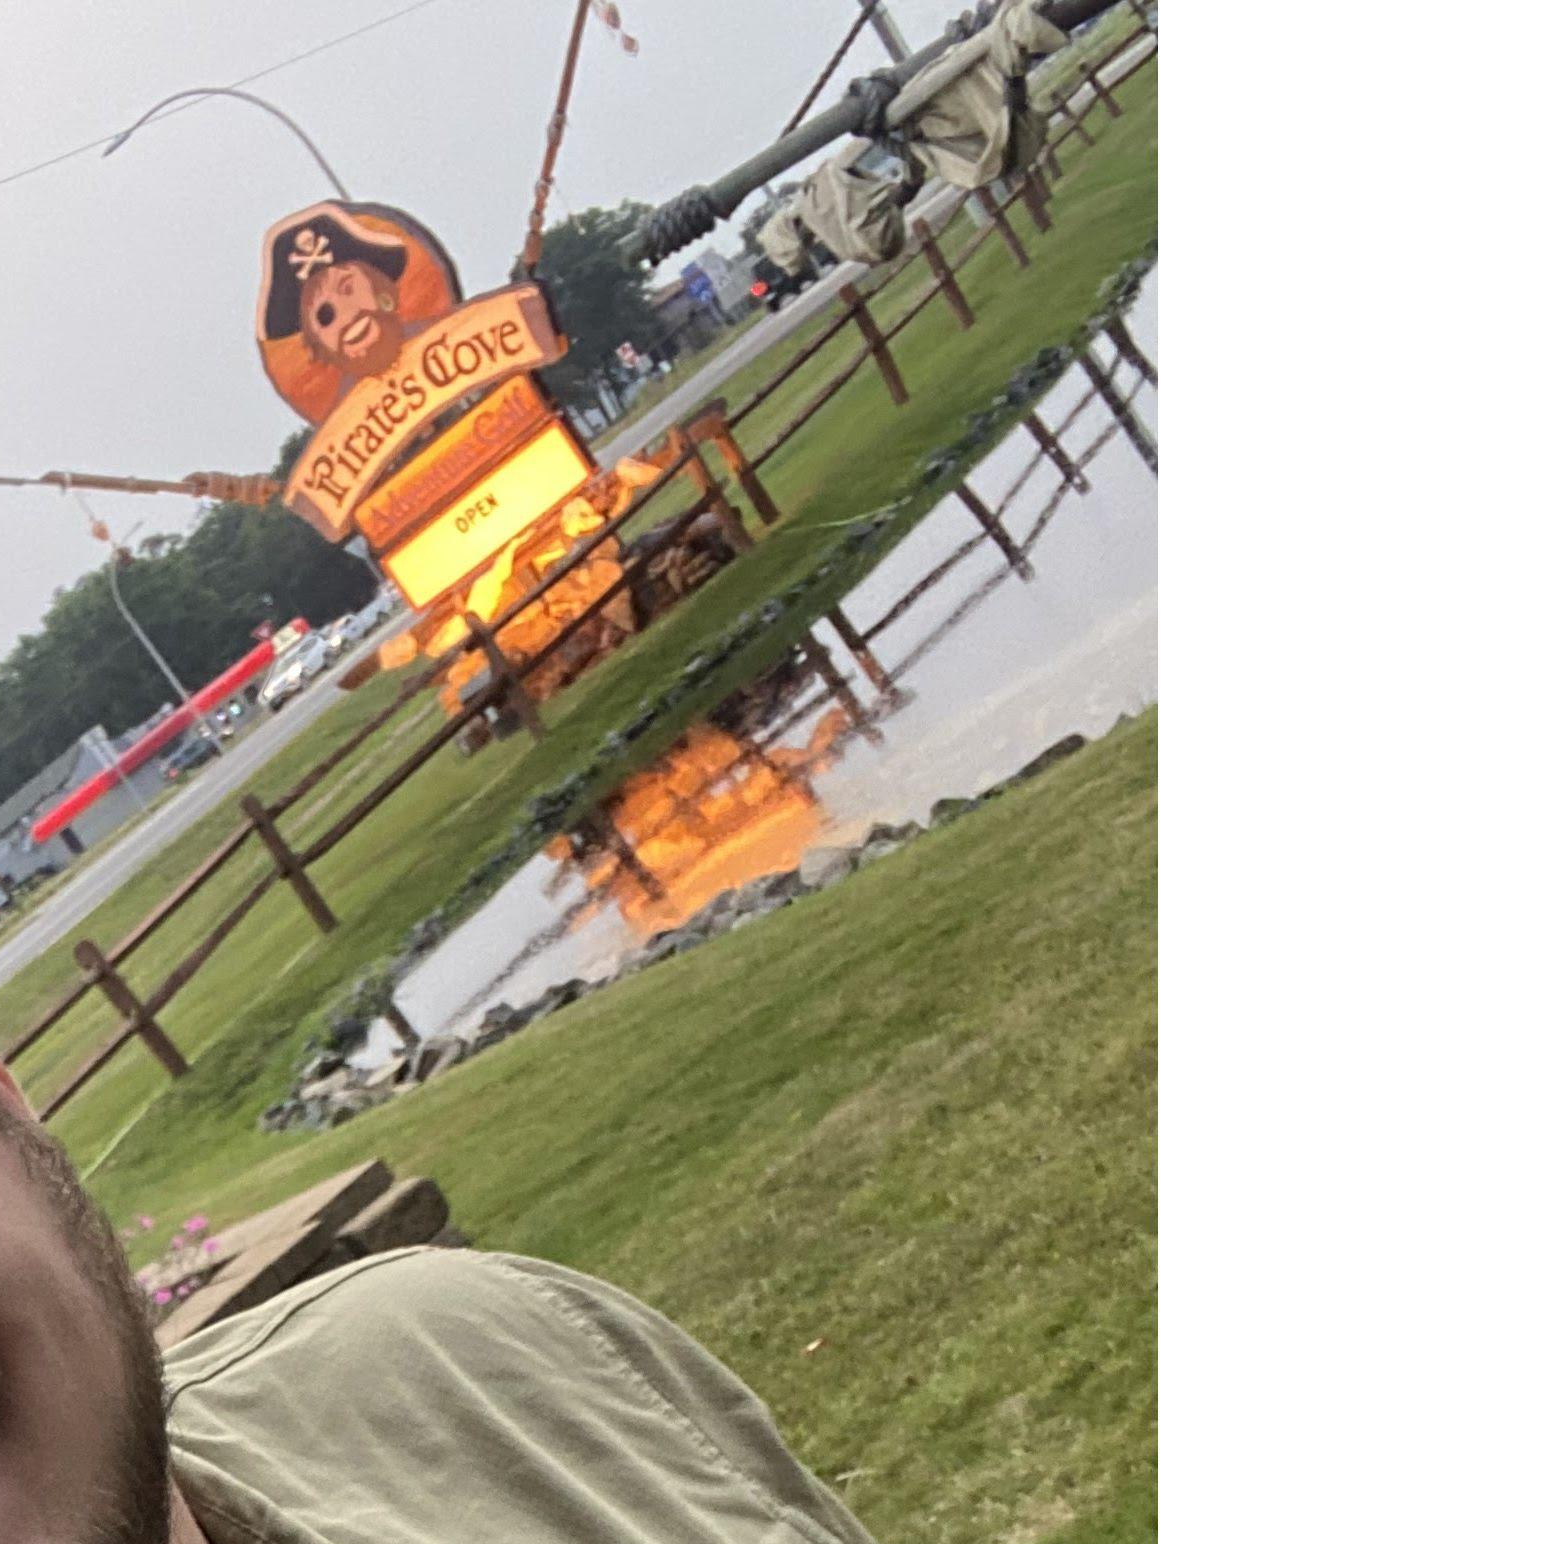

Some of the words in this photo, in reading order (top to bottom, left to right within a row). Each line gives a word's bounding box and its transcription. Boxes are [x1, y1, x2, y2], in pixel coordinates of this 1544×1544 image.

[304, 372, 426, 508] Pirate's
[422, 320, 524, 388] Cove
[455, 493, 498, 533] OPEN
